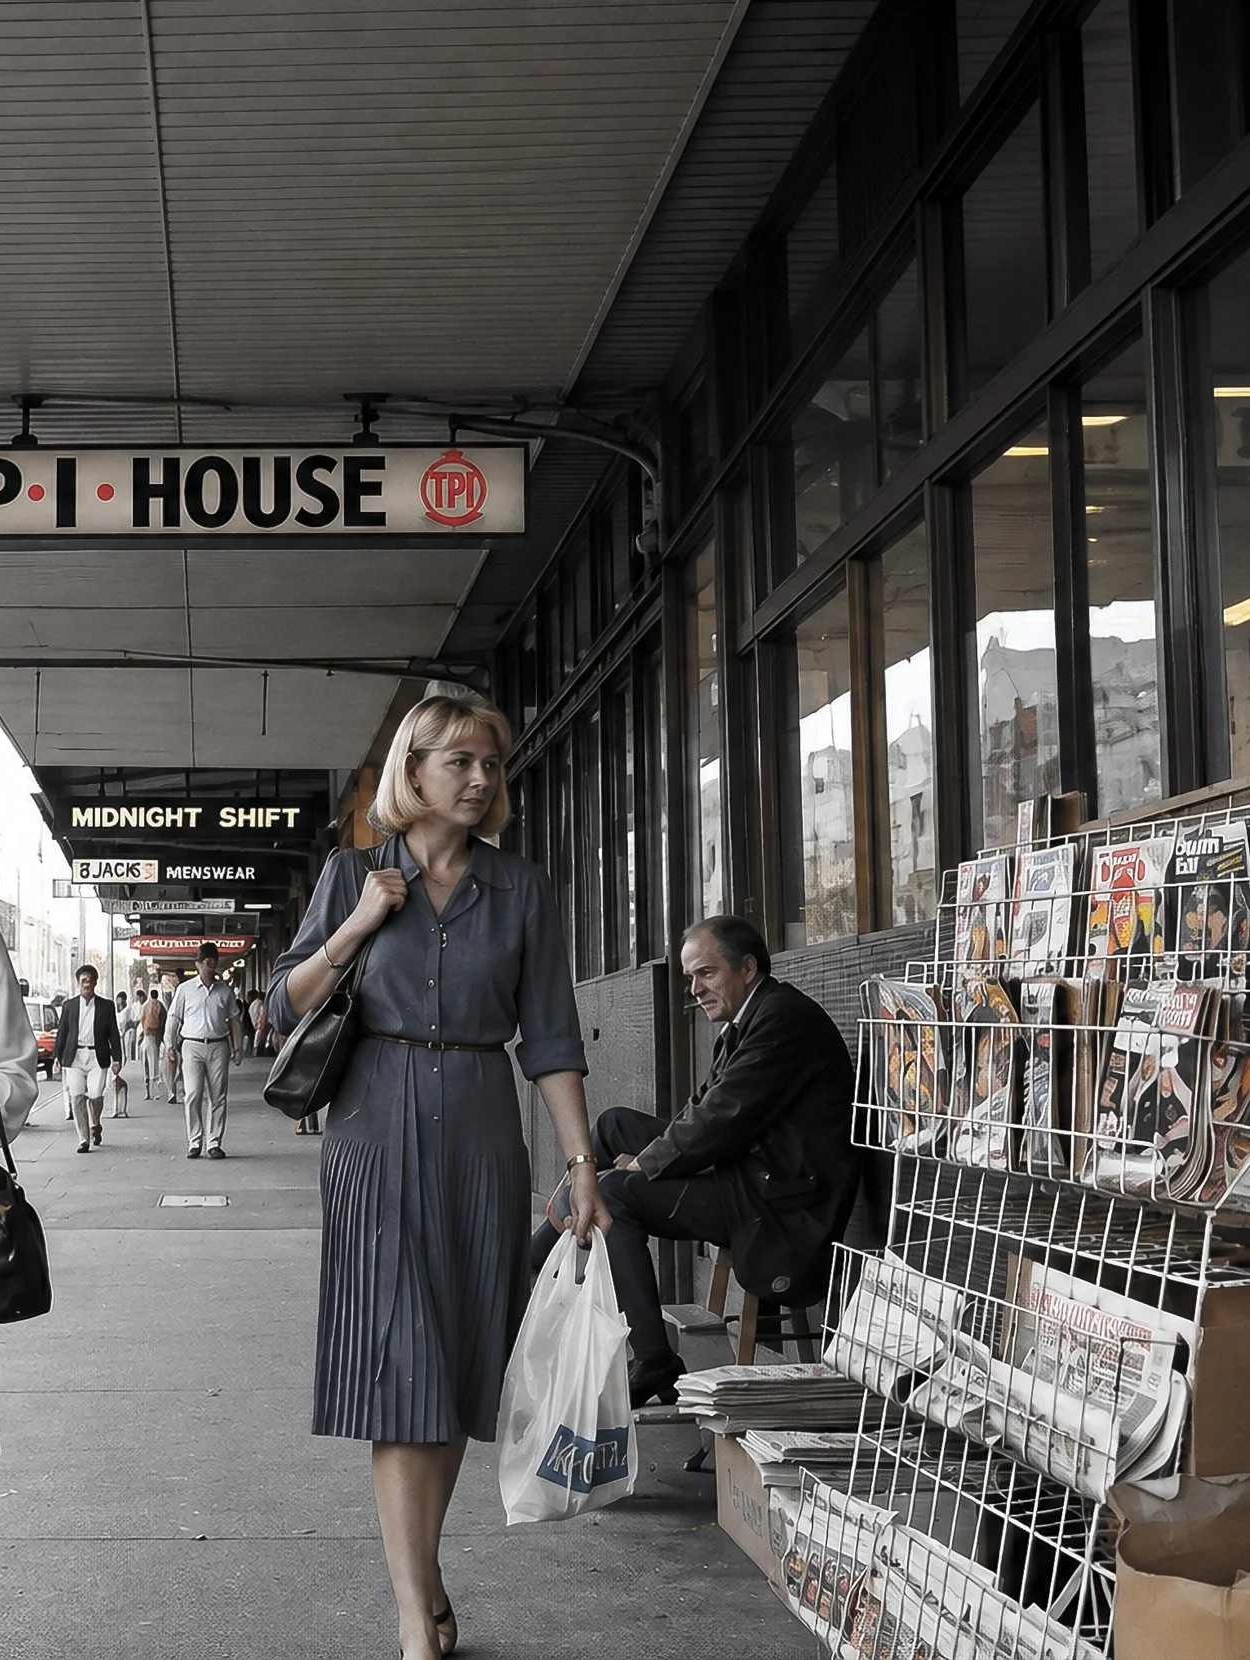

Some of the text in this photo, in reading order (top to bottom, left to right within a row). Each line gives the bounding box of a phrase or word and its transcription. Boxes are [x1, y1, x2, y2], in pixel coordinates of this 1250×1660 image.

[131, 453, 387, 531] HOUSE
[429, 471, 476, 509] TPI
[71, 806, 301, 828] MIDNIGHT SHIFT
[166, 866, 256, 880] MENSWEAR
